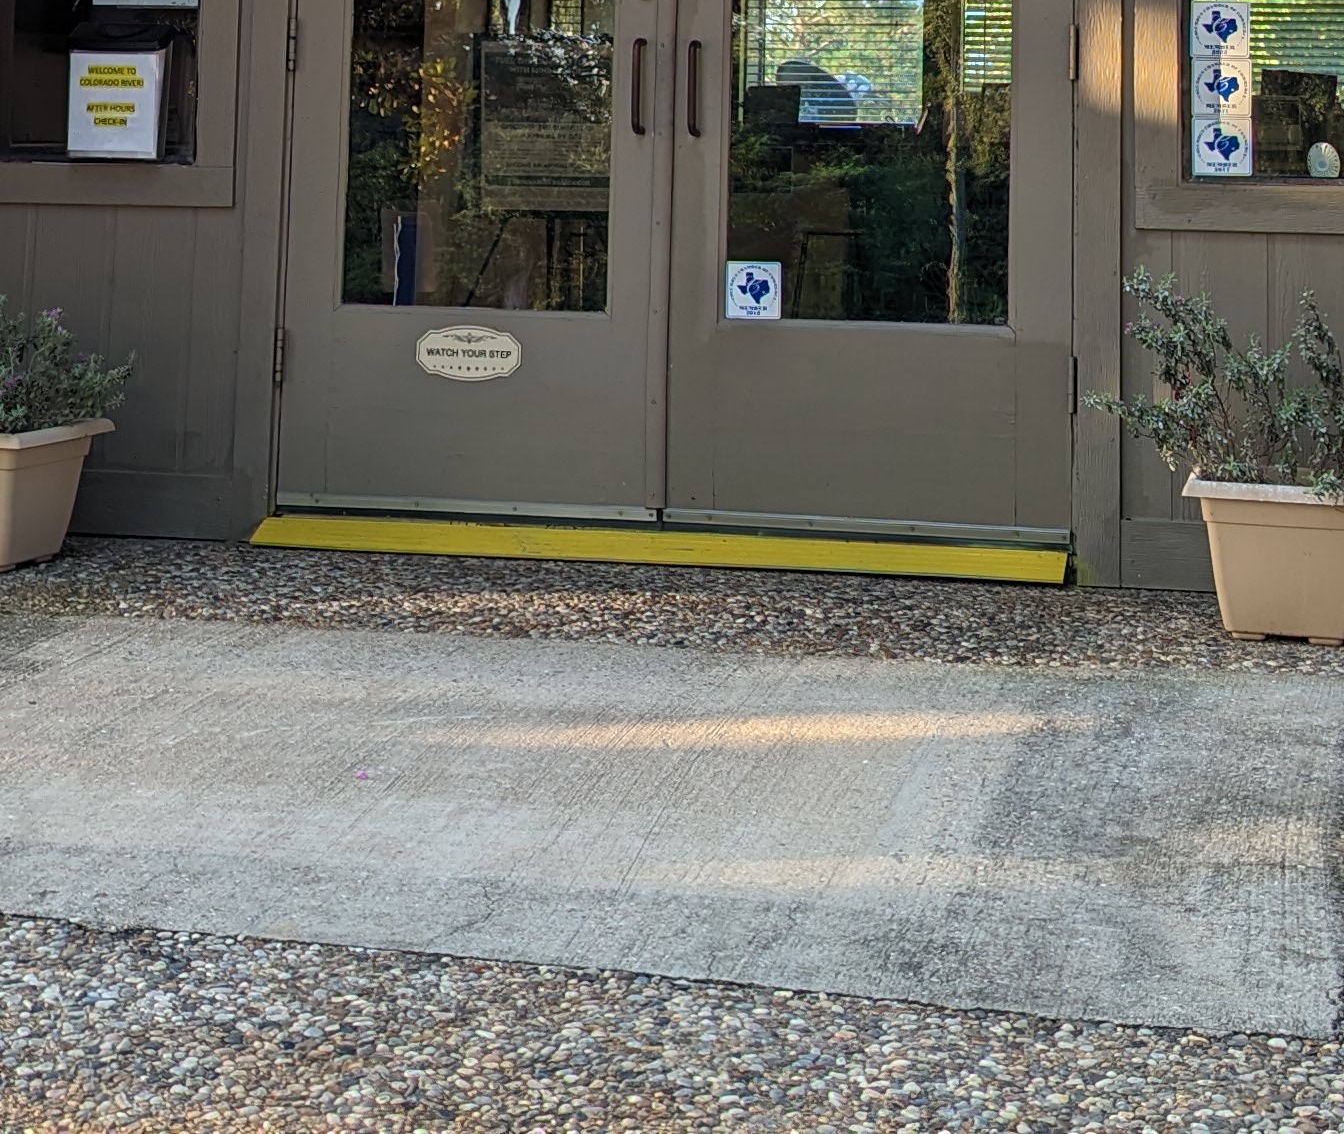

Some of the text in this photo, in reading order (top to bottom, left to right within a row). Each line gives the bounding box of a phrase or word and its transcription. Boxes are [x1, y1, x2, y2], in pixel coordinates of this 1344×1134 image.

[88, 67, 136, 75] WELCOME TO
[80, 78, 119, 87] COLORADO
[86, 105, 135, 113] AFTER HOURS
[94, 117, 127, 126] CHECK-IN
[426, 348, 512, 359] WATCH YOUR STEP
